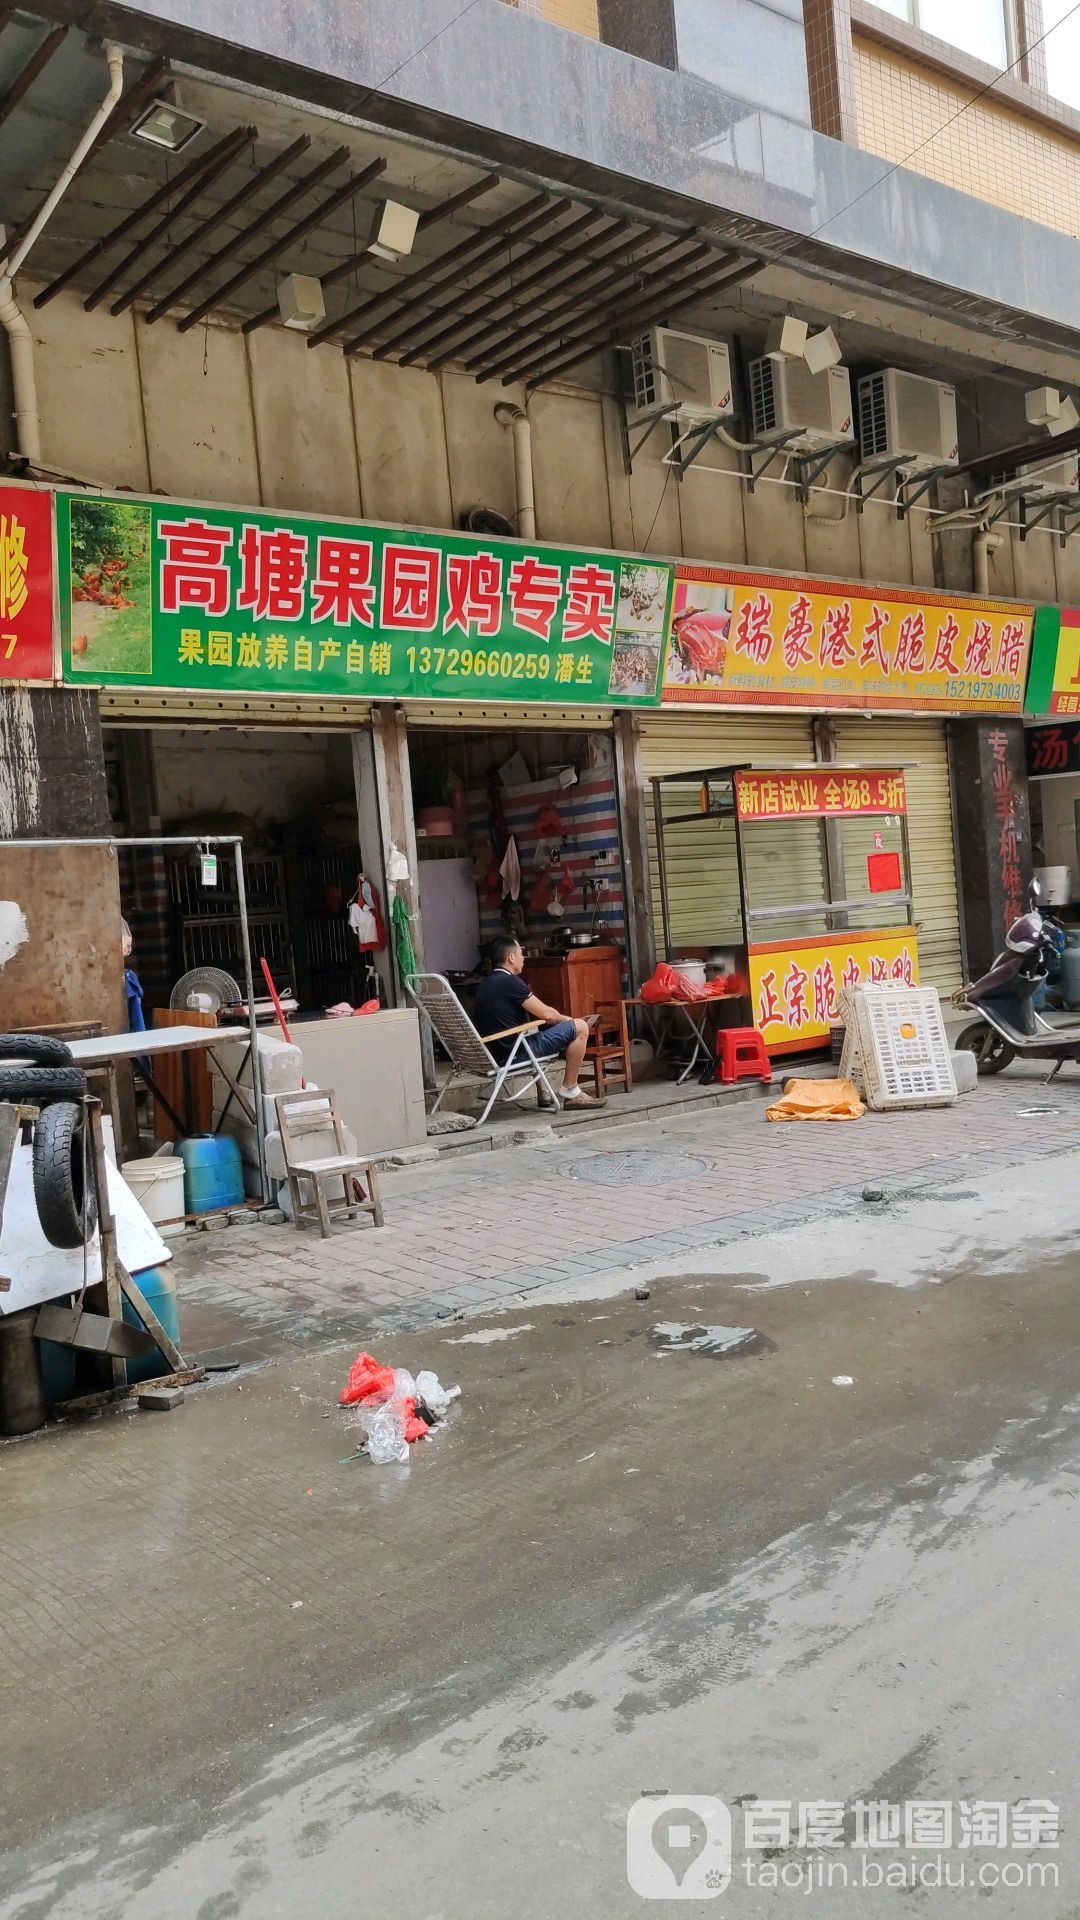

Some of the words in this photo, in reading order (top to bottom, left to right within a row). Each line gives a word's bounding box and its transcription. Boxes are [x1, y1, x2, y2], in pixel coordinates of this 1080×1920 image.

[0, 513, 28, 621] 修
[157, 517, 616, 646] 高塘果园鸡专卖
[177, 628, 393, 676] 果园放养自产自销
[406, 646, 550, 680] 13729660259
[554, 653, 594, 684] 潘生
[734, 593, 1025, 678] 瑞豪港式脆皮烧腊
[945, 680, 1021, 700] 15219734003
[1056, 695, 1080, 713] 经营
[1032, 727, 1080, 770] 汤
[739, 779, 820, 814] 新店试业
[823, 777, 904, 811] 全场8.5折
